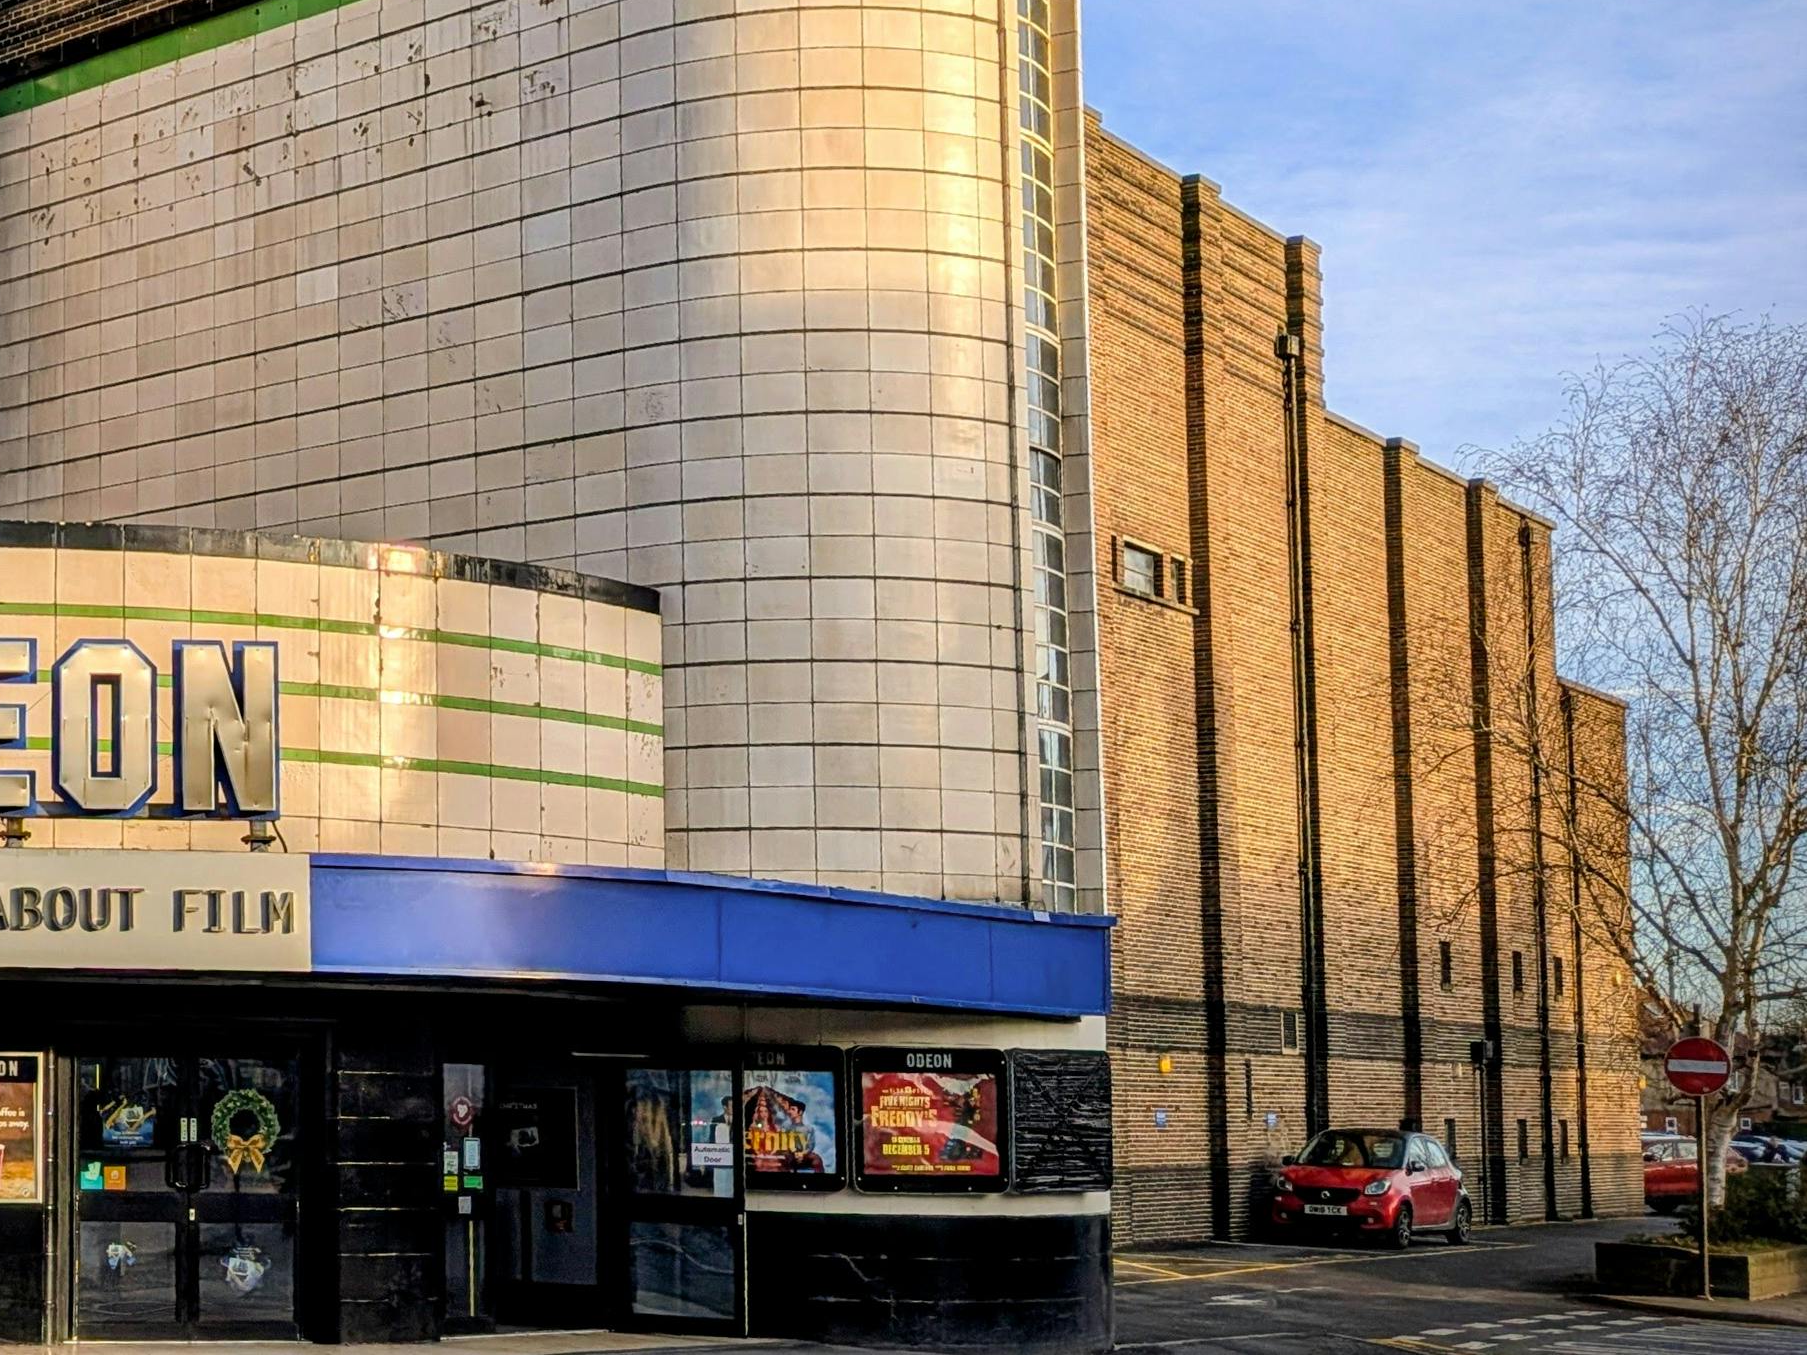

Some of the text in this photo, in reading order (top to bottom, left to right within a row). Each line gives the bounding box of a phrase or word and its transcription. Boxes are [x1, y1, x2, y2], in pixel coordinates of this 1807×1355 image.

[172, 887, 295, 936] FILM
[906, 1053, 953, 1068] ODEON
[879, 1095, 931, 1108] FIVE NIGHTS
[18, 1107, 26, 1117] is
[8, 1120, 30, 1131] away.
[882, 1144, 922, 1155] DECEMBER
[704, 1155, 723, 1164] Door
